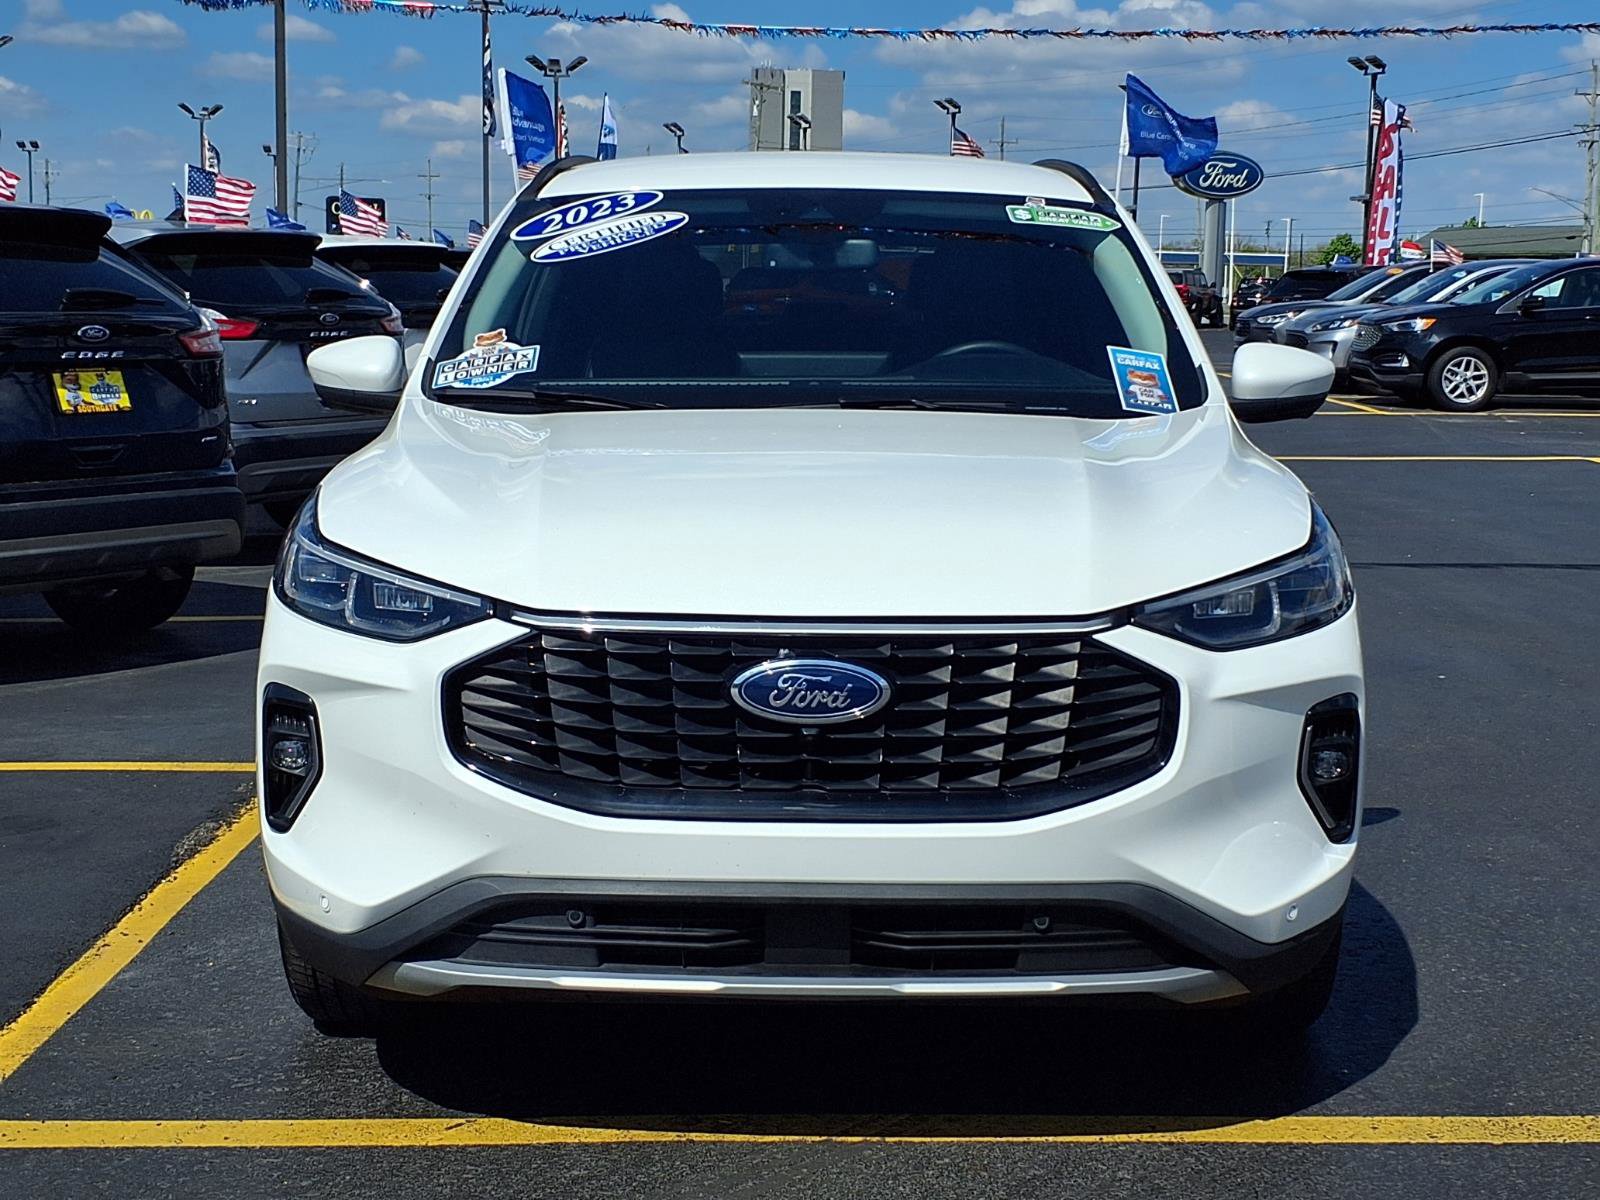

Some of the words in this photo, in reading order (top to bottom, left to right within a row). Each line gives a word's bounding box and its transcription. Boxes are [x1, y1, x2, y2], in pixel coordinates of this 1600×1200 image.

[1199, 161, 1249, 188] Ford
[542, 193, 636, 235] 2023
[548, 213, 667, 251] CERTIFIED
[443, 352, 531, 372] CARFAX
[455, 361, 529, 379] OWNER
[1117, 358, 1160, 369] CARFAX
[77, 404, 119, 413] SOUTHGATE
[768, 673, 853, 708] Ford
